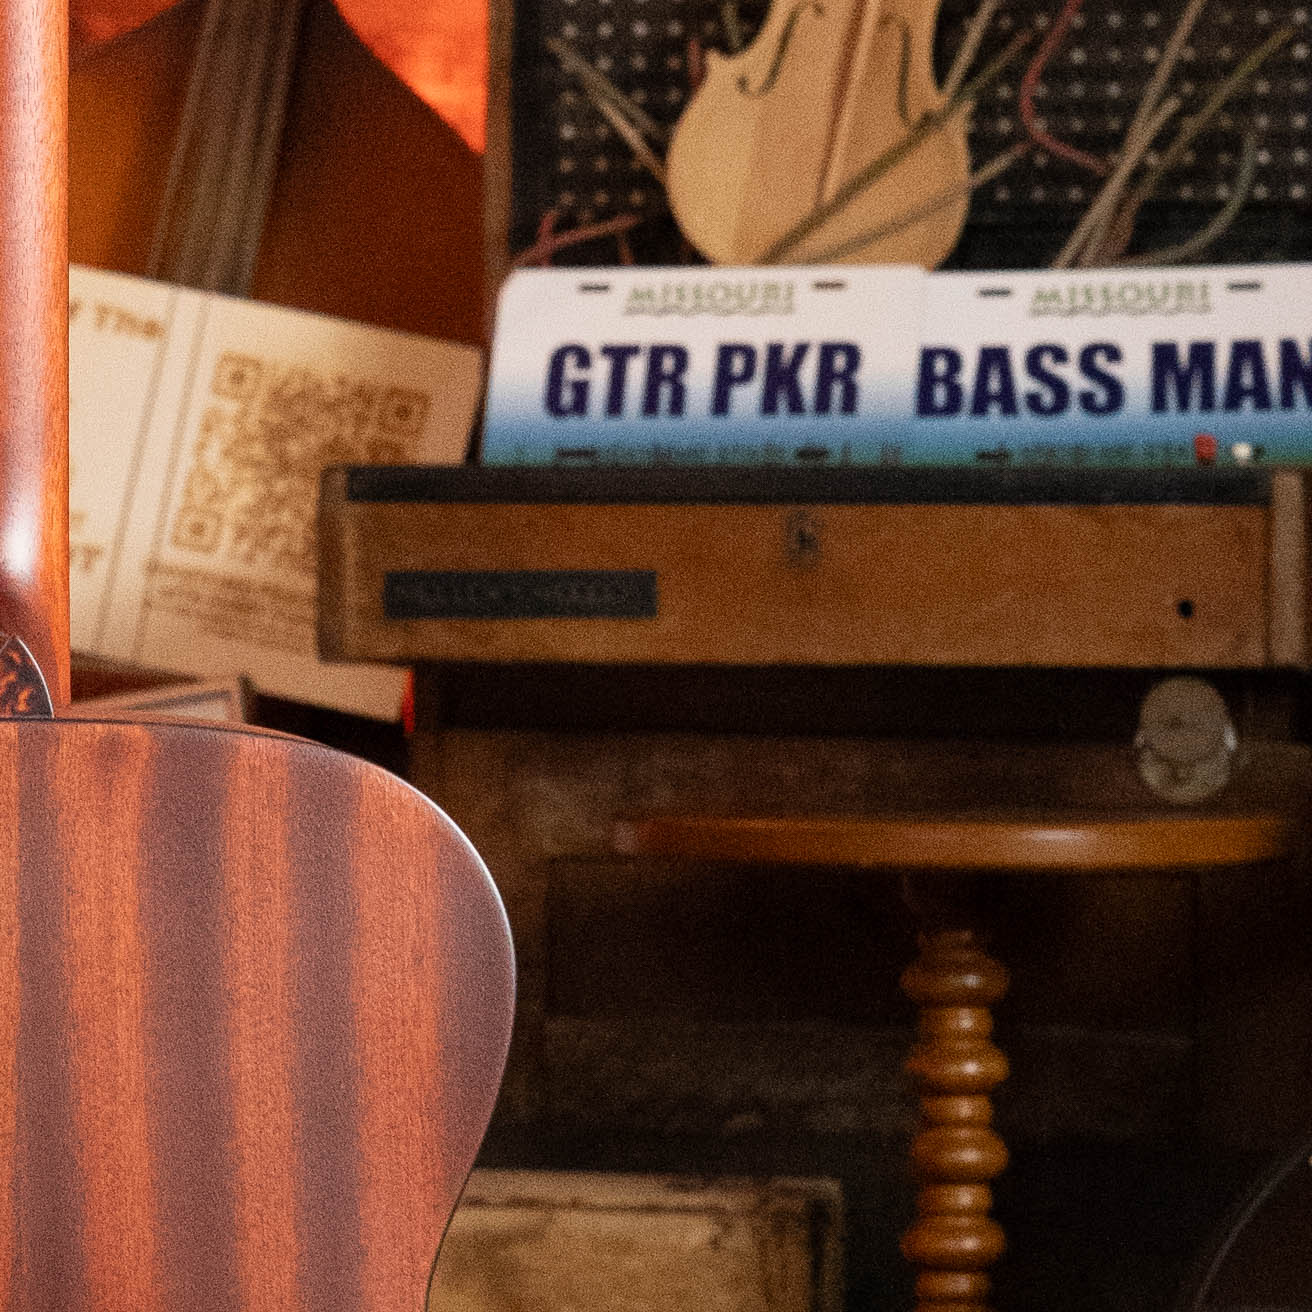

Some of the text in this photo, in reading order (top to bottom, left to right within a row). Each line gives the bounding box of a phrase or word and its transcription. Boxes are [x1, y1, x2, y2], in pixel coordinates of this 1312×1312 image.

[543, 339, 863, 420] GTR PKR
[915, 337, 1312, 420] BASS MAN
